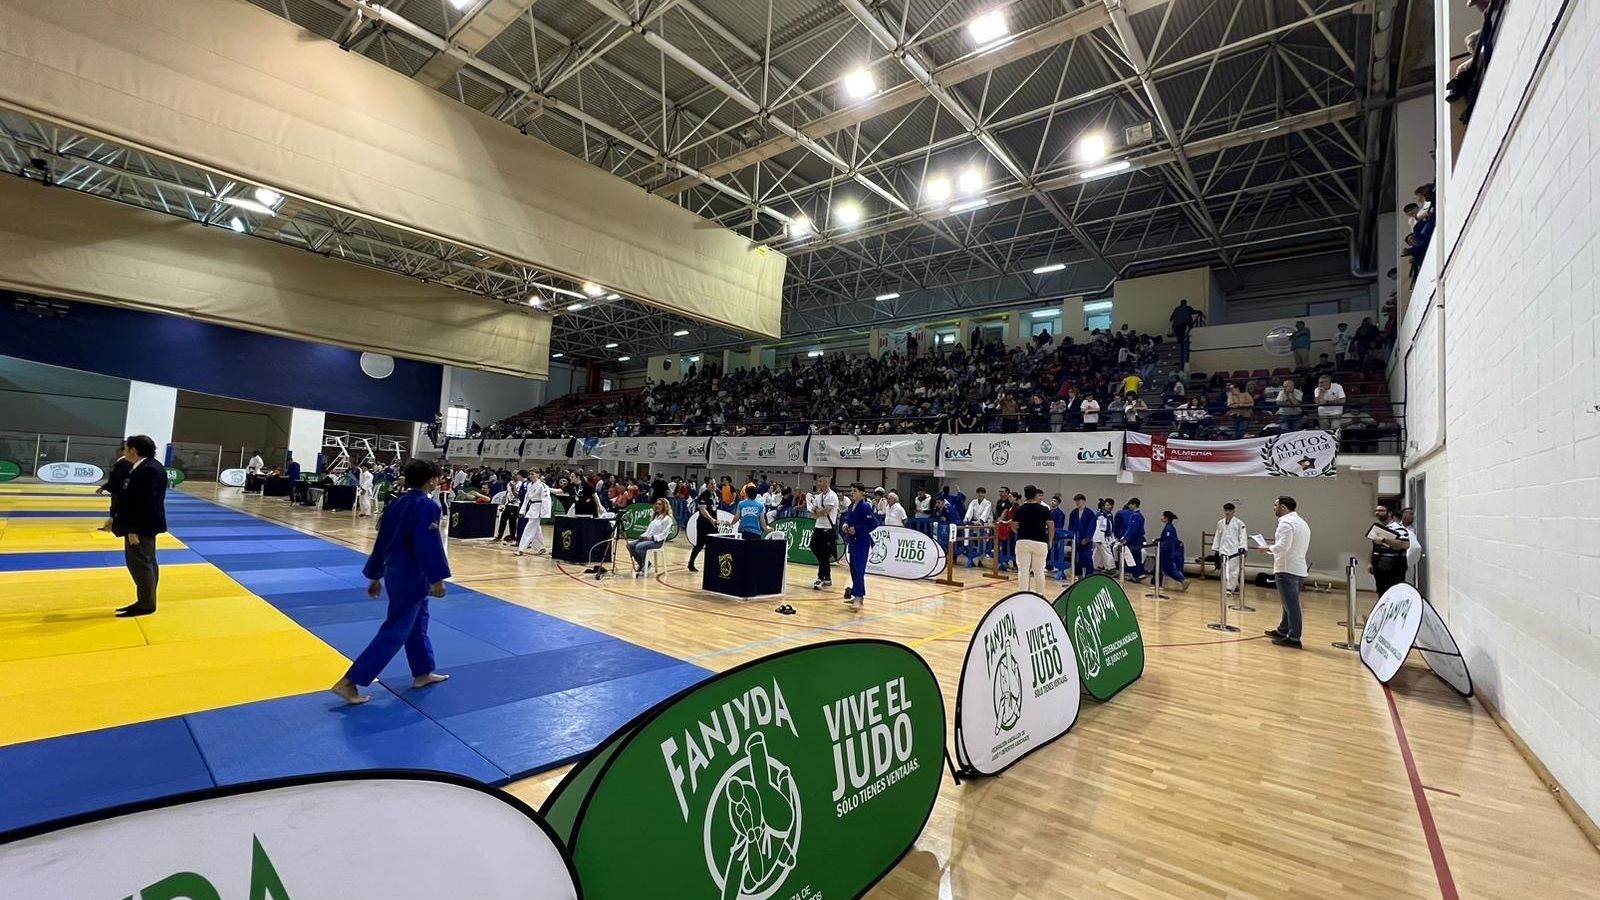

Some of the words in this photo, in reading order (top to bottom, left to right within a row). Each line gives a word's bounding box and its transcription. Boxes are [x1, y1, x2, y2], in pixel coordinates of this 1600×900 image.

[1275, 434, 1328, 454] MYTOS
[1278, 449, 1303, 461] JUDO
[1305, 443, 1331, 454] CLUB
[895, 547, 925, 561] JUDO
[898, 539, 916, 549] VIVE
[917, 540, 927, 550] EL
[984, 610, 1020, 679] FANJYDA
[1026, 625, 1046, 653] VIVE
[1045, 622, 1058, 645] EL
[1030, 645, 1063, 688] JUDO
[822, 685, 883, 742] VIVE
[886, 676, 912, 717] EL
[660, 677, 799, 823] FANJYDA
[832, 712, 913, 802] JUDO
[836, 794, 859, 818] SÓLO
[859, 778, 886, 804] TIENES
[887, 758, 920, 787] VENTAJAS.
